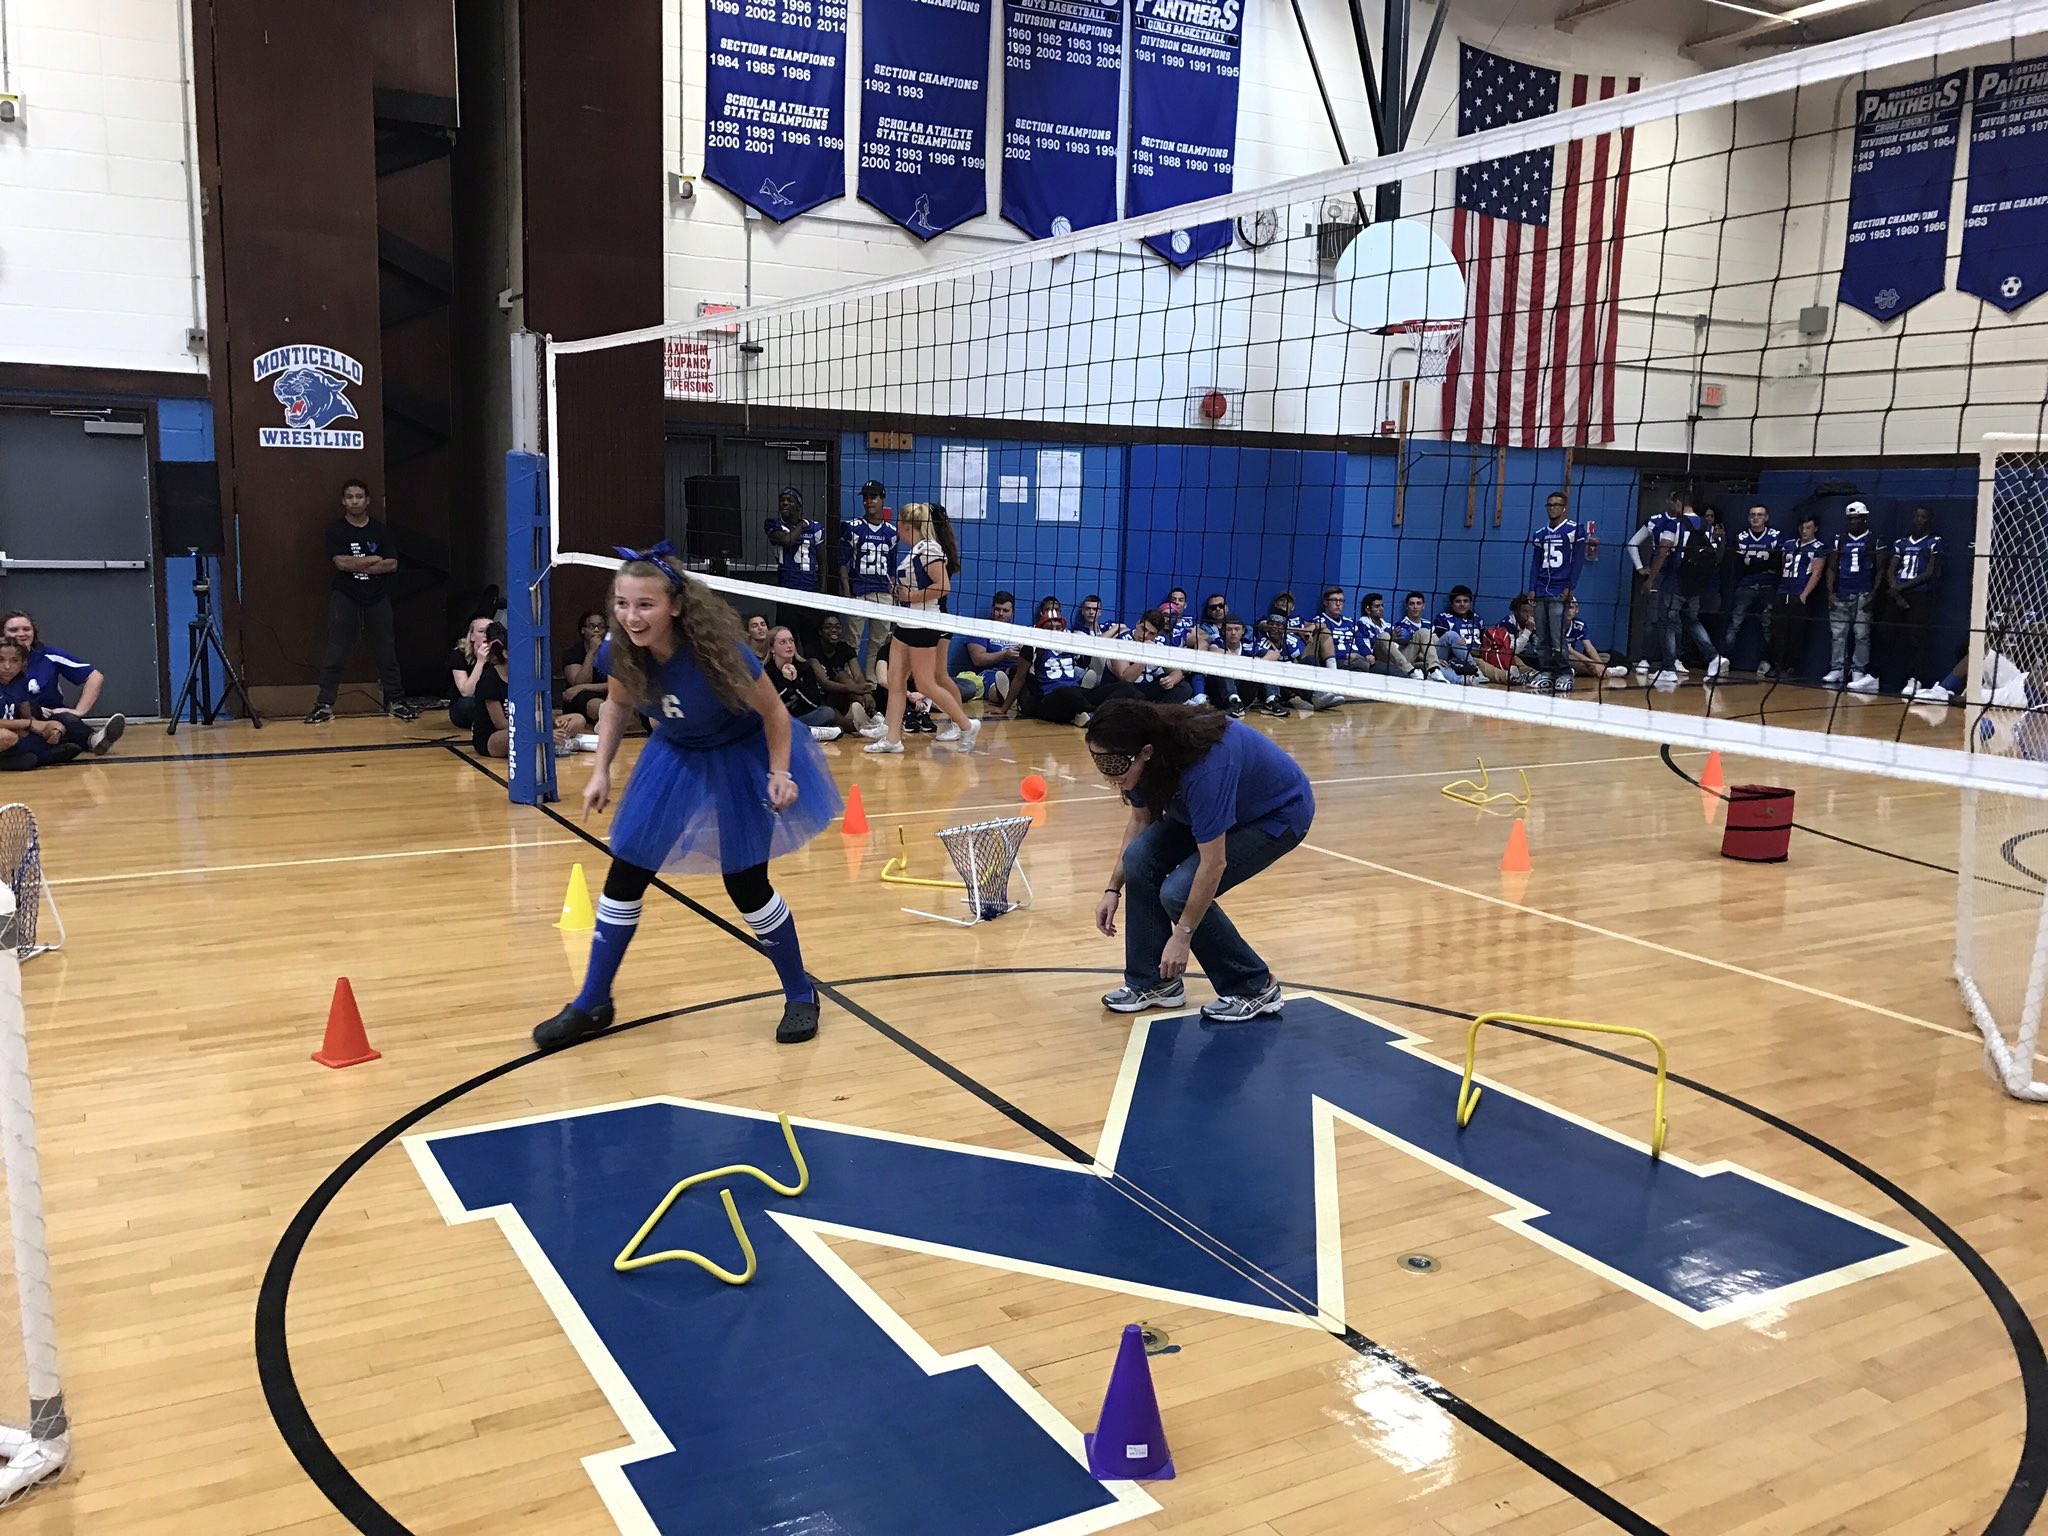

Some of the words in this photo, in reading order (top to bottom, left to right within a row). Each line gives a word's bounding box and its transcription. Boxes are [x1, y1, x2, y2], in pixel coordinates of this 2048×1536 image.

[710, 0, 739, 15] 1999
[745, 5, 776, 22] 2002
[782, 12, 811, 28] 2010
[817, 19, 846, 33] 2014
[783, 0, 811, 13] 1996
[818, 5, 846, 19] 1998
[919, 0, 980, 13] AMPIONS
[1048, 1, 1105, 20] BASKETBALL
[1014, 12, 1056, 28] DIVISION
[1059, 20, 1112, 38] CHAMPIONS
[1147, 20, 1172, 33] GIRLS
[1173, 25, 1226, 44] BASKETBALL
[720, 38, 768, 56] SECTION
[770, 47, 835, 67] CHAMPIONS
[1007, 27, 1031, 41] 1960
[1037, 32, 1062, 46] 1962
[1067, 37, 1091, 51] 1963
[1097, 42, 1121, 55] 1994
[1140, 35, 1180, 51] DIVISION
[1181, 43, 1231, 61] CHAMPIONS
[1006, 56, 1031, 70] 2015
[1007, 41, 1031, 55] 1999
[1036, 46, 1062, 60] 2002
[1066, 51, 1091, 65] 2003
[1096, 56, 1120, 69] 2006
[1135, 49, 1156, 63] 1981
[1161, 55, 1185, 68] 1990
[1189, 60, 1211, 73] 1991
[1216, 65, 1239, 77] 1995
[710, 53, 739, 69] 1984
[746, 60, 775, 75] 1985
[782, 66, 811, 81] 1986
[874, 64, 917, 81] SECTION
[919, 72, 978, 90] CHAMPIONS
[865, 79, 890, 94] 1992
[897, 85, 923, 99] 1993
[724, 105, 760, 121] STATE
[763, 112, 828, 130] CHAMPIONS
[726, 93, 775, 111] SCHOLAR
[779, 102, 829, 119] ATHLETE
[879, 117, 923, 133] SCHOLAR
[926, 125, 973, 140] ATHLETE
[1015, 118, 1054, 133] SECTION
[1055, 125, 1111, 140] CHAMPIONS
[1981, 112, 2022, 128] DIVISON
[709, 120, 739, 134] 1992
[746, 125, 775, 140] 1993
[782, 131, 810, 145] 1996
[818, 136, 843, 150] 1999
[709, 135, 739, 149] 2000
[745, 140, 773, 154] 2001
[877, 128, 909, 142] STATE
[911, 134, 971, 151] CHAMPIONS
[1006, 133, 1030, 146] 1964
[1036, 137, 1060, 150] 1990
[1066, 141, 1090, 154] 1993
[1861, 134, 1899, 149] DIVISION
[1900, 125, 1949, 142] CHAMPONS
[863, 142, 890, 156] 1992
[896, 147, 922, 161] 1993
[929, 152, 955, 165] 1996
[962, 156, 985, 169] 1999
[1005, 147, 1031, 160] 2002
[1141, 136, 1176, 152] SECTION
[1177, 143, 1229, 159] CHAMPIONS
[862, 156, 890, 169] 2000
[895, 161, 921, 174] 2001
[1132, 149, 1153, 163] 1981
[1158, 155, 1181, 168] 1988
[1185, 159, 1208, 171] 1990
[1132, 163, 1154, 177] 1995
[1971, 202, 2013, 214] SECTON
[1853, 217, 1887, 230] SECTION
[1888, 210, 1939, 224] CHAMPONS
[1849, 232, 1866, 243] 950
[1870, 228, 1892, 240] 1953
[1896, 225, 1919, 237] 1960
[256, 347, 361, 382] MONTICELLO
[672, 380, 714, 393] PERSONS
[262, 430, 362, 447] WRESTLING
[793, 539, 811, 572] 4
[860, 541, 890, 576] 26
[1542, 539, 1564, 569] 15
[1850, 547, 1860, 573] 1
[661, 694, 686, 719] 6
